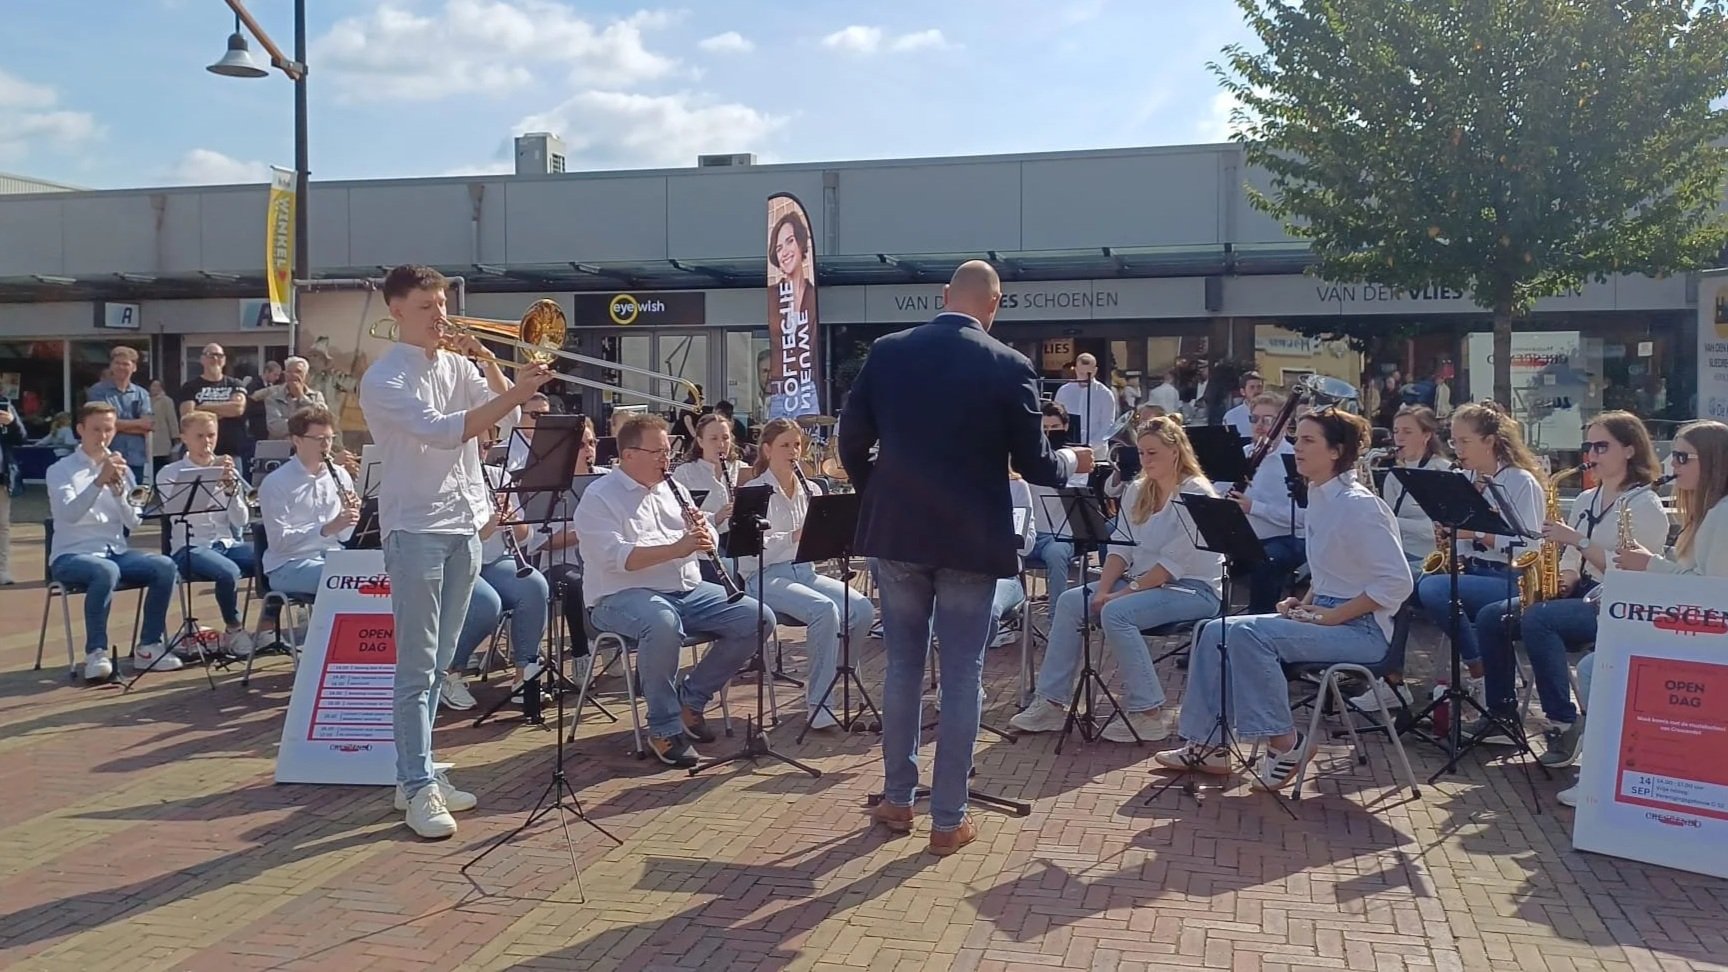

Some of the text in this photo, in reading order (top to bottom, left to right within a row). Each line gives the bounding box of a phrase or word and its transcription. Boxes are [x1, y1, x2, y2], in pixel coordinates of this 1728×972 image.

[276, 197, 290, 268] WINKEL
[1317, 286, 1354, 301] VAN
[1408, 284, 1464, 301] VLIES
[895, 296, 928, 310] VAN
[1024, 292, 1119, 308] SCHOENEN
[1044, 343, 1070, 354] LIES
[798, 309, 813, 410] NIEUWE
[358, 628, 393, 639] OPEN
[358, 642, 387, 652] DAG
[1664, 680, 1705, 694] OPEN
[1669, 694, 1702, 708] DAG
[1639, 776, 1651, 785] 14
[1631, 785, 1650, 796] SEP
